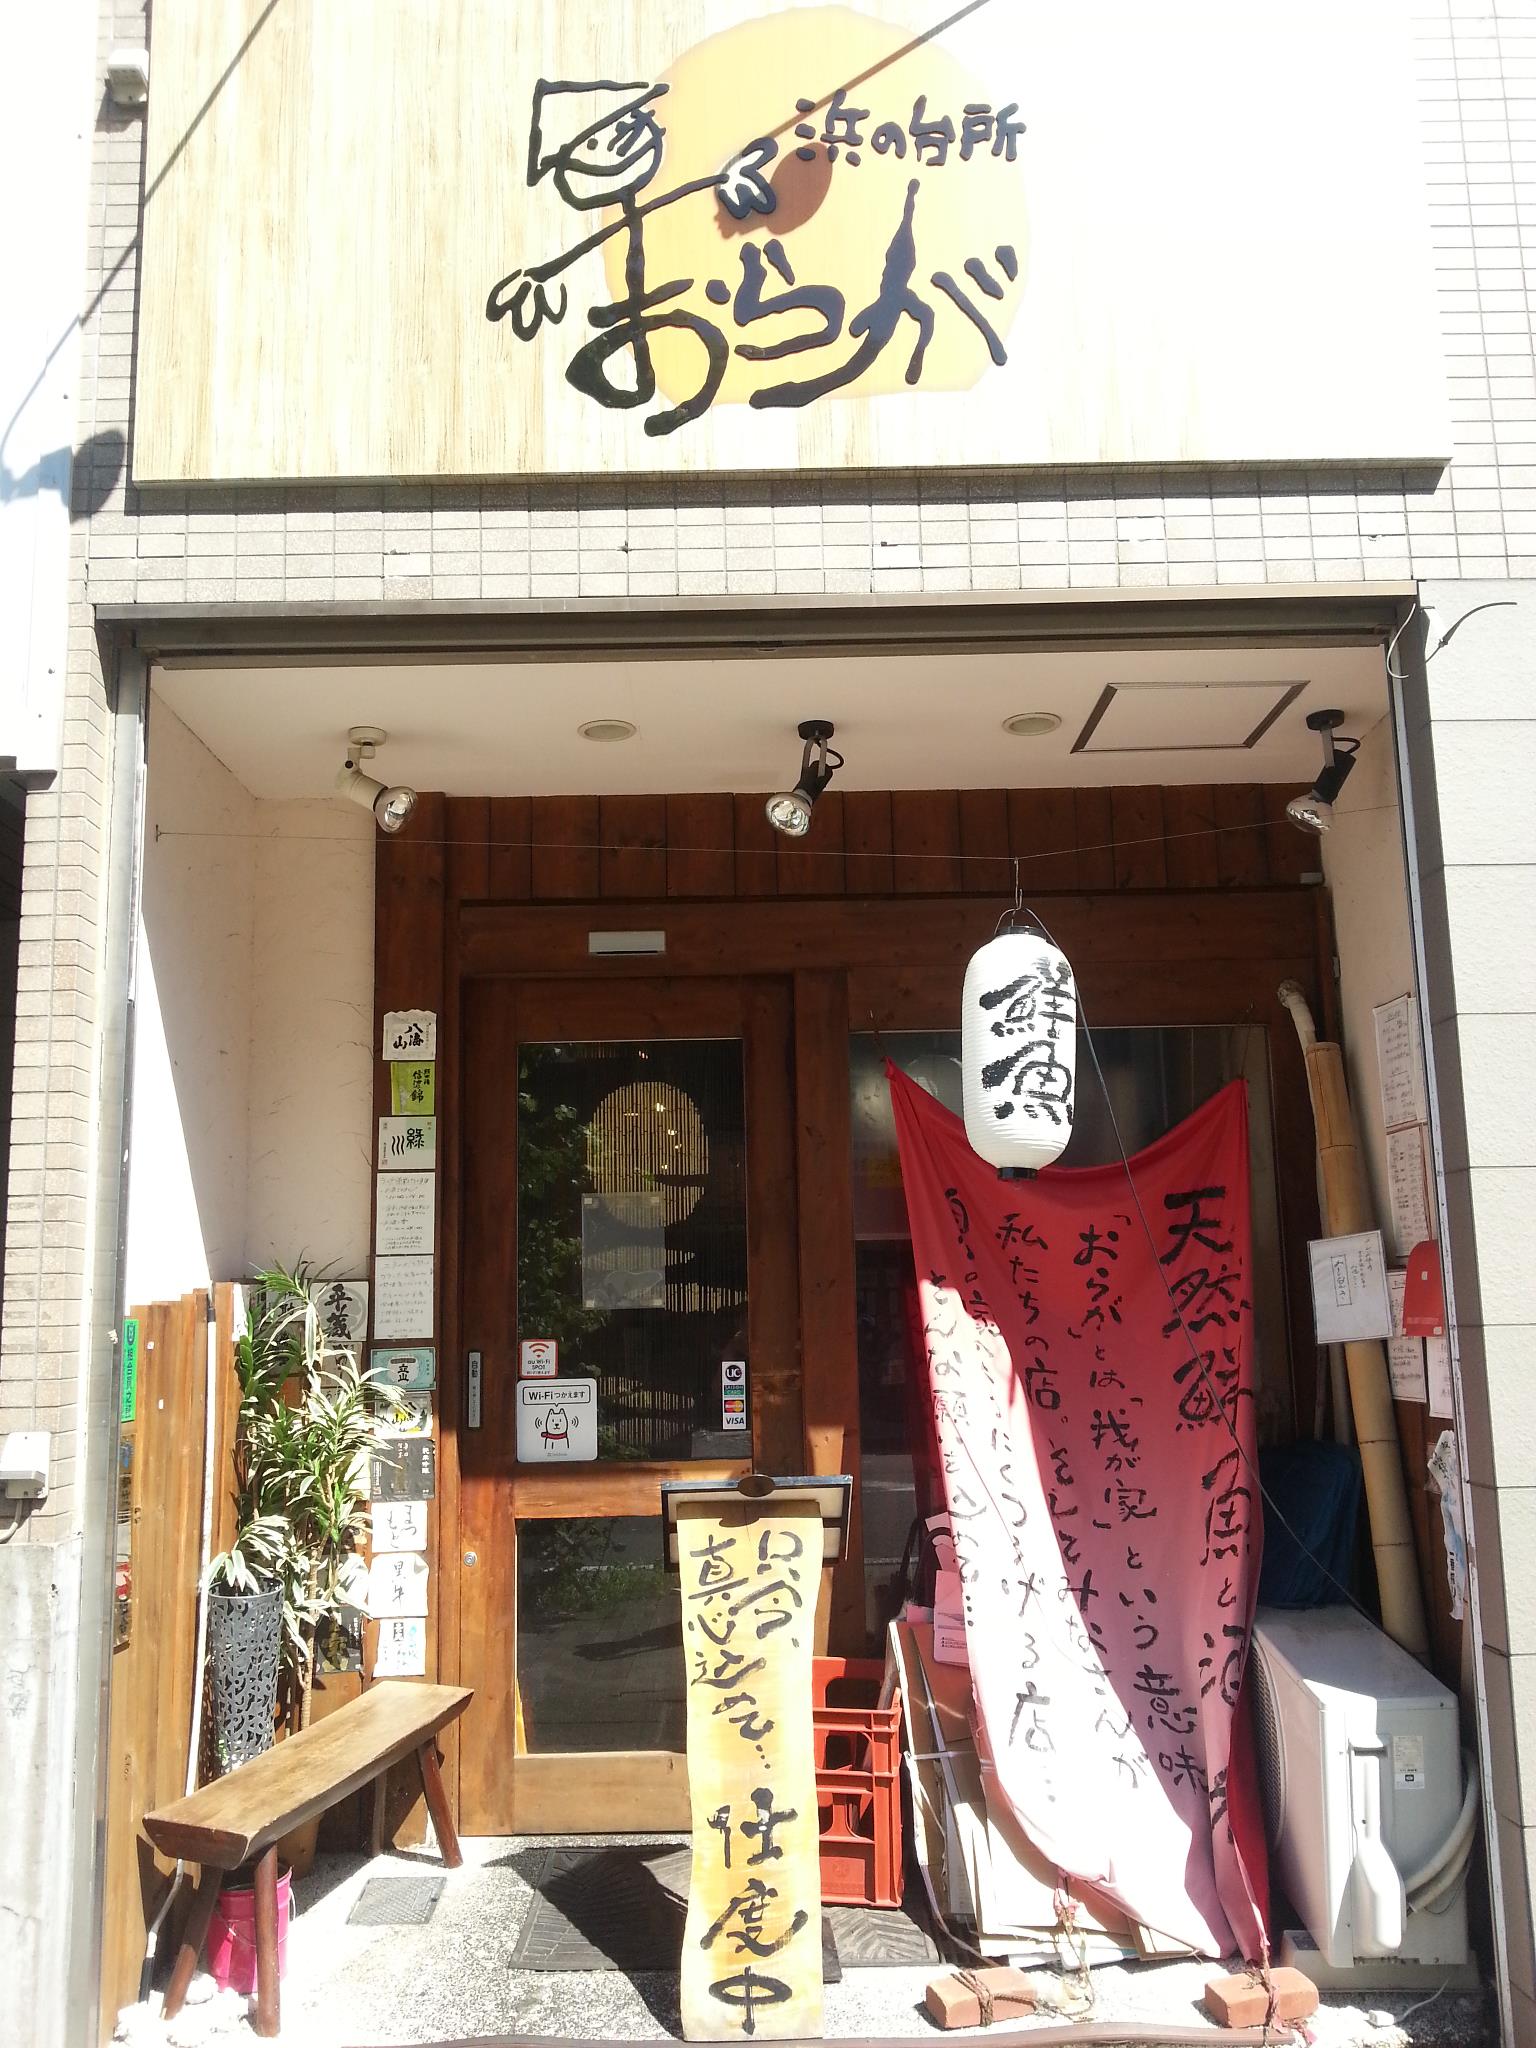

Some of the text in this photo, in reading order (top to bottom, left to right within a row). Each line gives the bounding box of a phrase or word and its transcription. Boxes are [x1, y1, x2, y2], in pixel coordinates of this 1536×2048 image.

[795, 88, 1027, 168] 浜の台所
[565, 178, 1020, 438] おらが
[393, 1023, 424, 1050] 八海山
[978, 956, 1076, 1126] 鮮魚
[397, 1363, 410, 1382] 立山
[726, 1368, 741, 1378] UC
[726, 1417, 745, 1425] VISA
[699, 1787, 811, 2037] 仕度中
